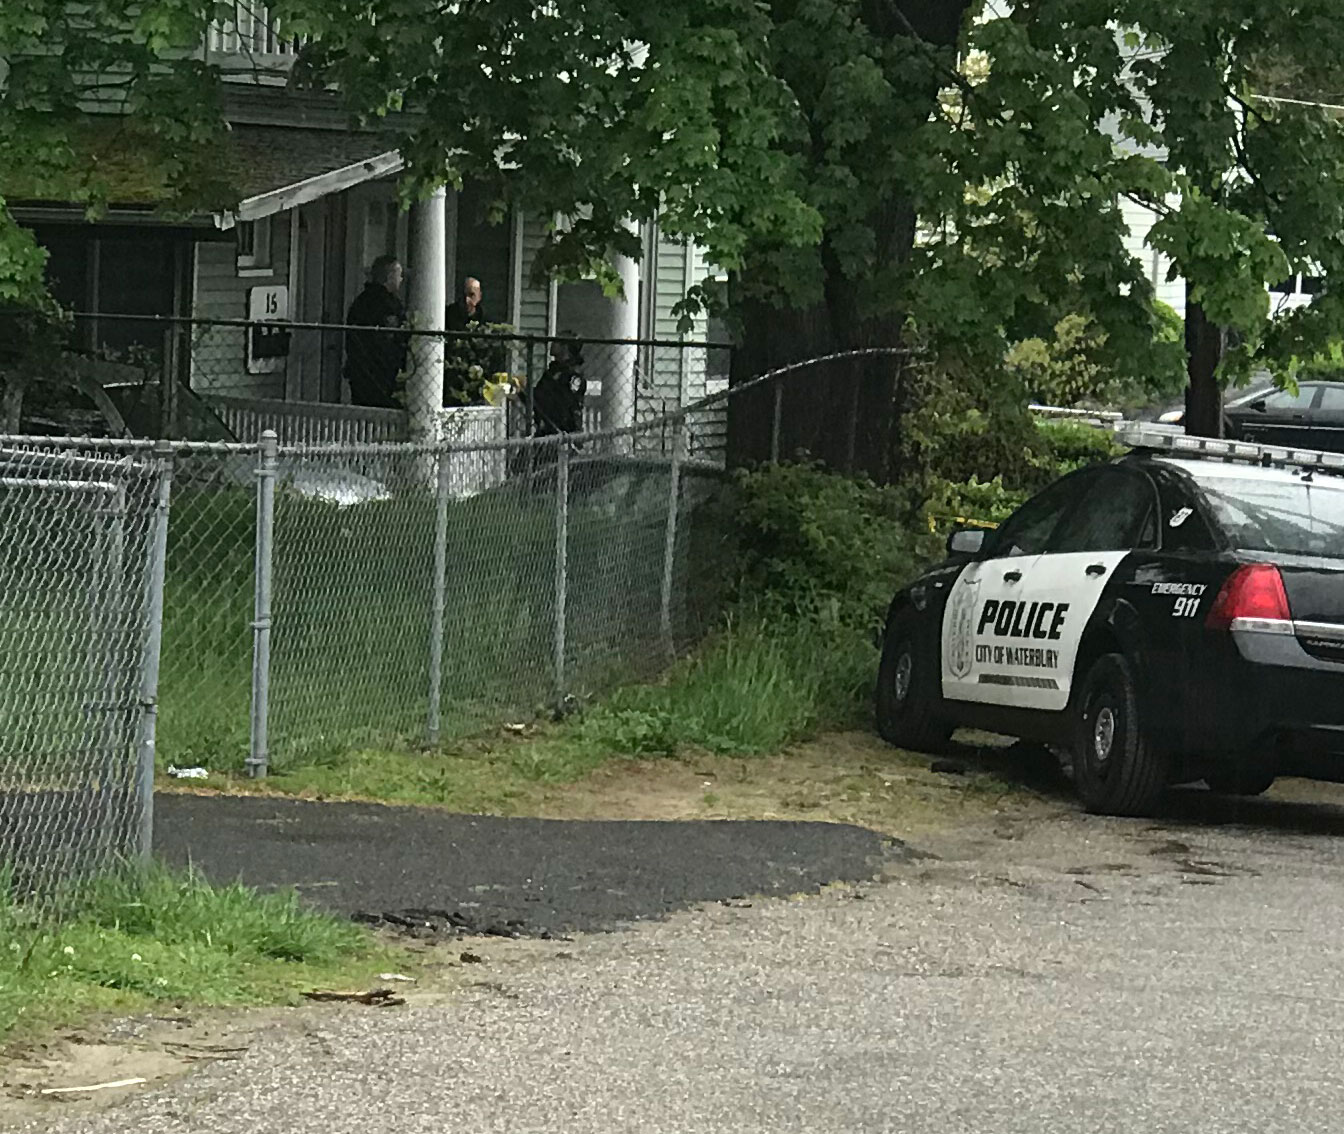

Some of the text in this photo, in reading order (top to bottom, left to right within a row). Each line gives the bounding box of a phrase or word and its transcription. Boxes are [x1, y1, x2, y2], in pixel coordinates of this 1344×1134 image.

[266, 292, 278, 314] 15
[1151, 582, 1208, 596] EMERGENCY
[1172, 597, 1201, 617] 911
[977, 599, 1070, 640] POLICE
[976, 644, 1059, 669] CITY OF WATERBURY
